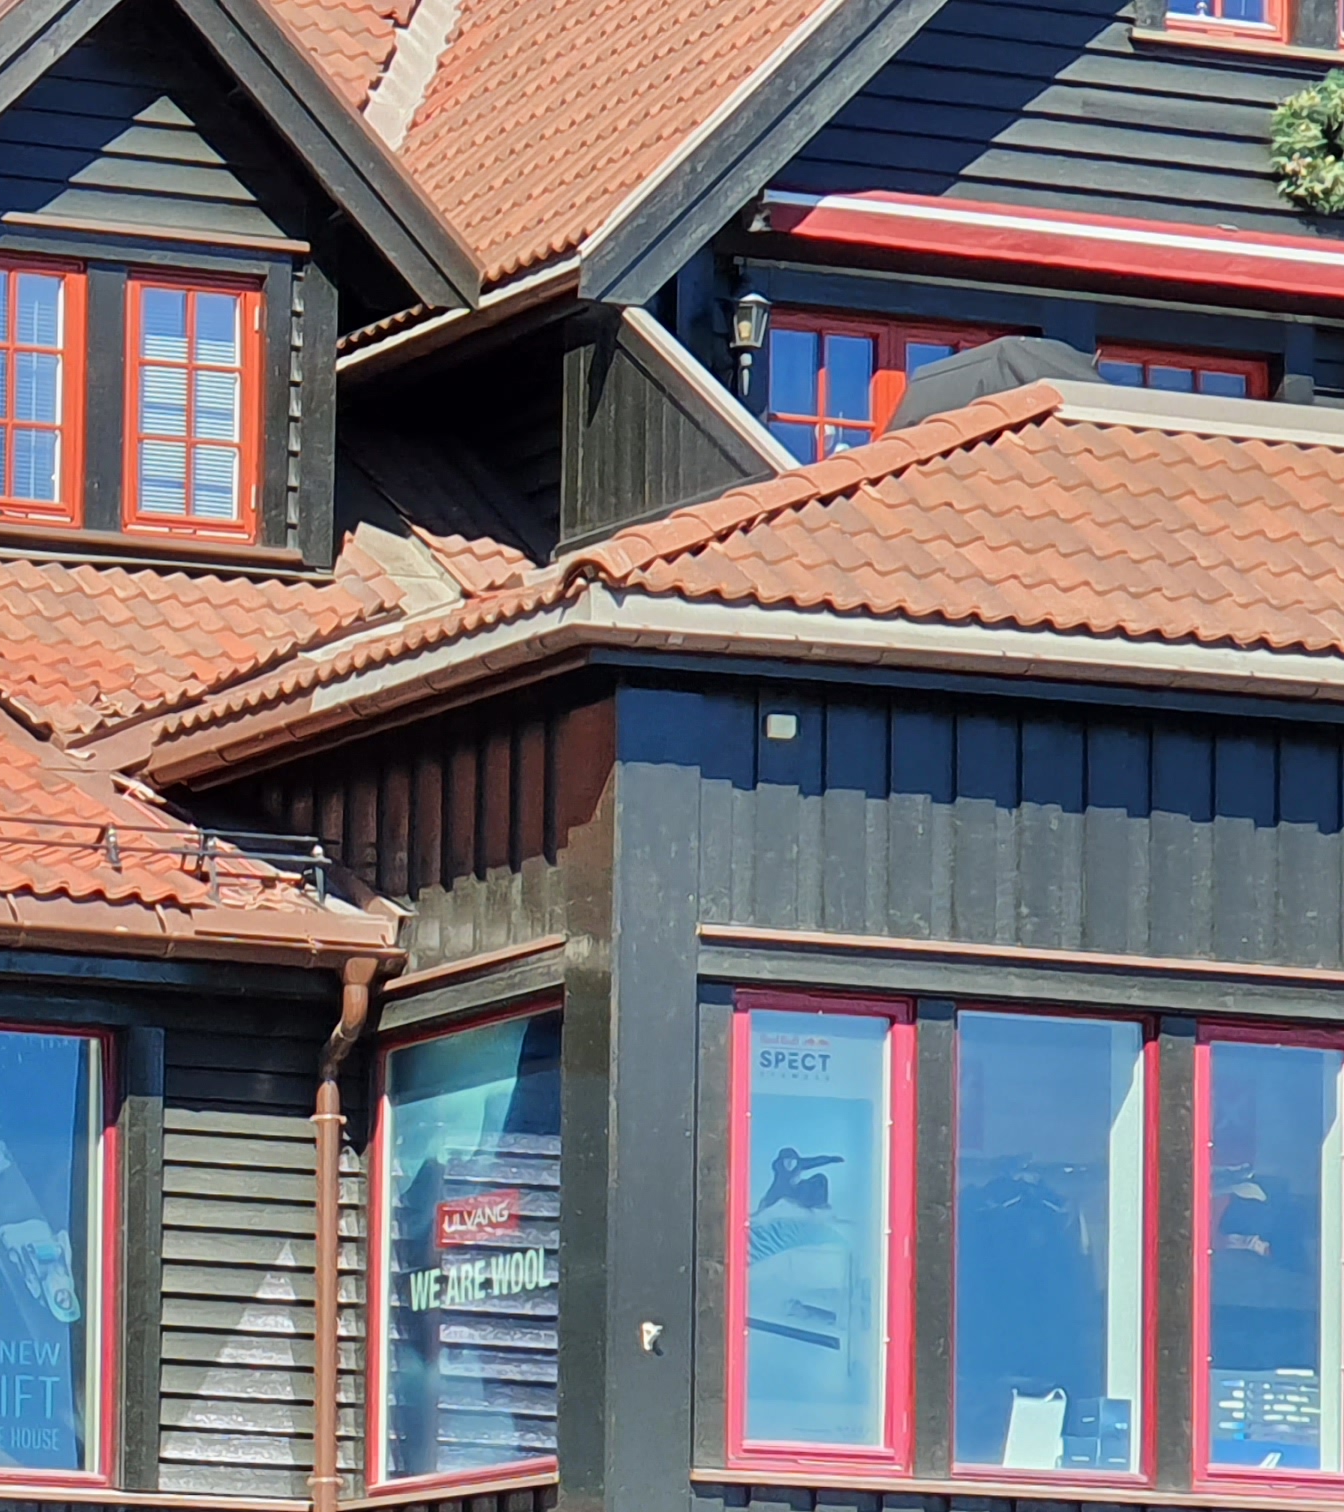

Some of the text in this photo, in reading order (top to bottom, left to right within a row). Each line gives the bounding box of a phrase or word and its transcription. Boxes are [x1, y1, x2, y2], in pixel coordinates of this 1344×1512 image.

[759, 1050, 831, 1073] SPECT
[443, 1200, 511, 1233] ULVANG
[410, 1247, 551, 1312] WE ARE WOOL
[0, 1340, 60, 1366] NEW
[11, 1427, 61, 1451] HOUSE
